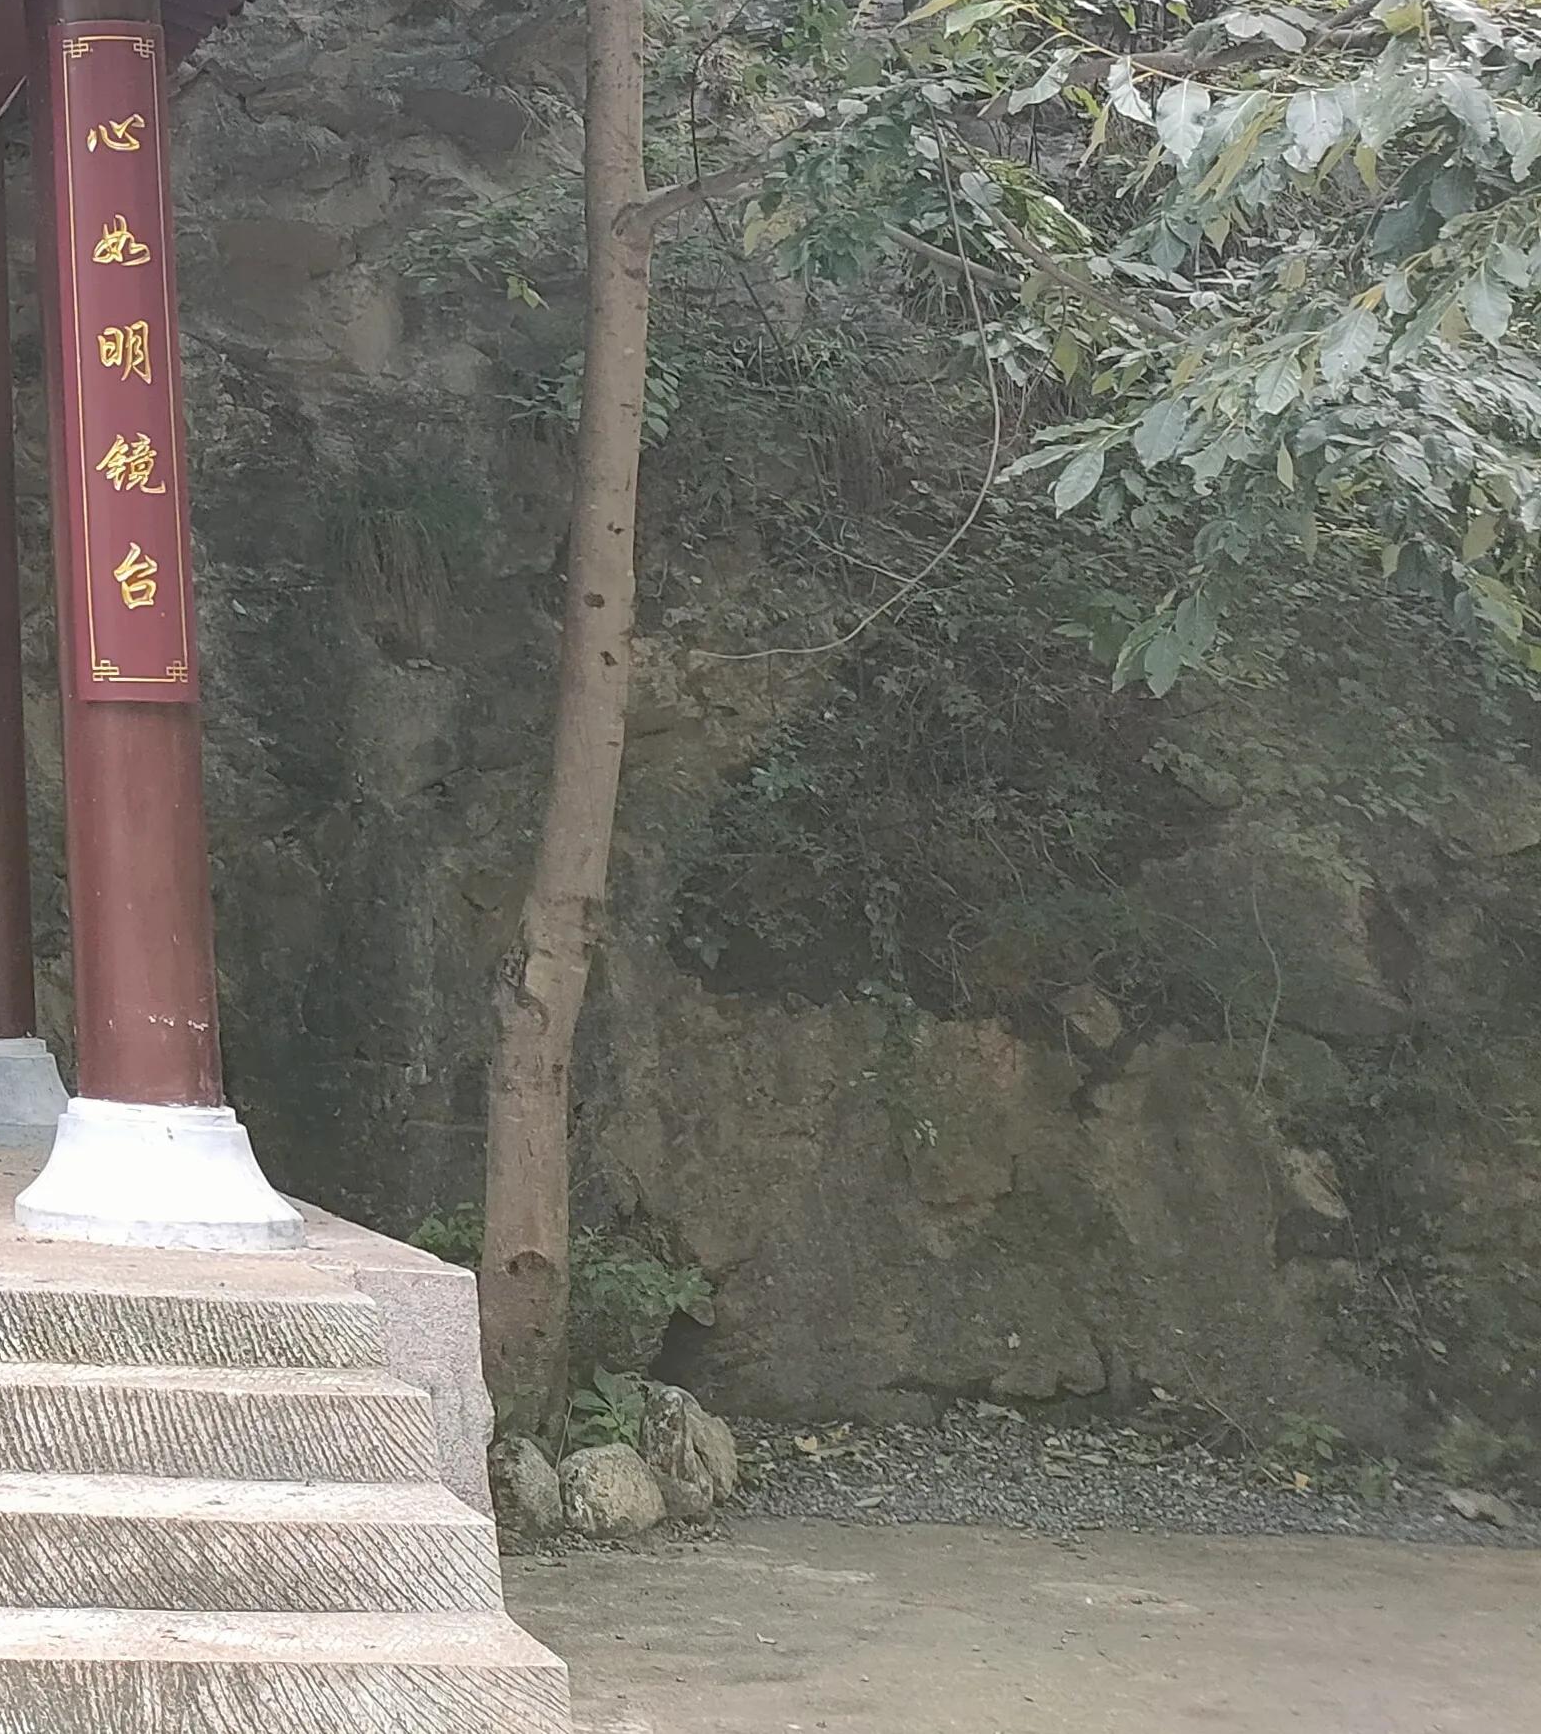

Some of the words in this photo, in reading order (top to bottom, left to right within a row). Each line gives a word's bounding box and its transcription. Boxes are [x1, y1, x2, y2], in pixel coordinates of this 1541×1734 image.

[85, 112, 169, 610] 心如明镜台
